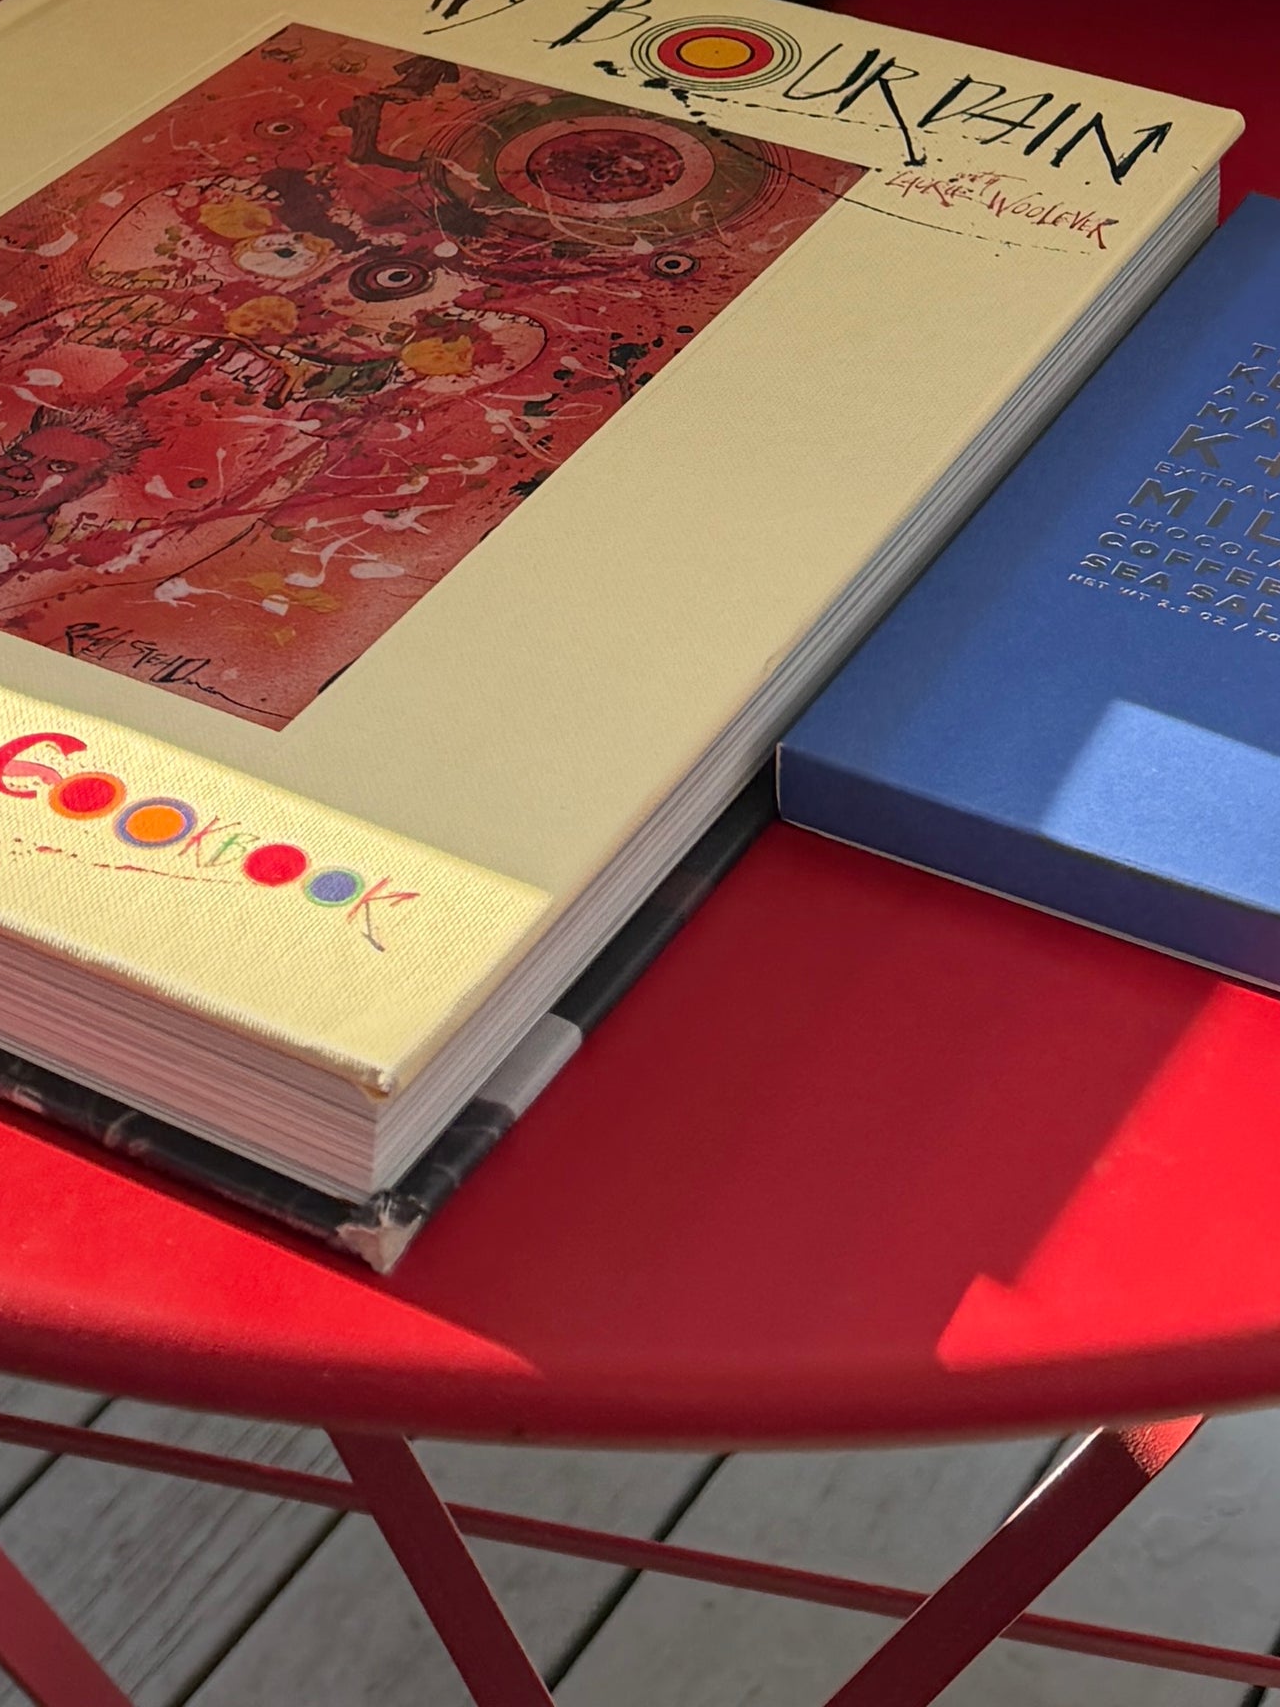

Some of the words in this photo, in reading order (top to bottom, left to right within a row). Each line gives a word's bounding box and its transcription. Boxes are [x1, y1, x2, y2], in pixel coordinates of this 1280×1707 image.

[982, 191, 1119, 249] WOOLEVER
[1168, 423, 1242, 469] K
[1079, 553, 1171, 592] SEA
